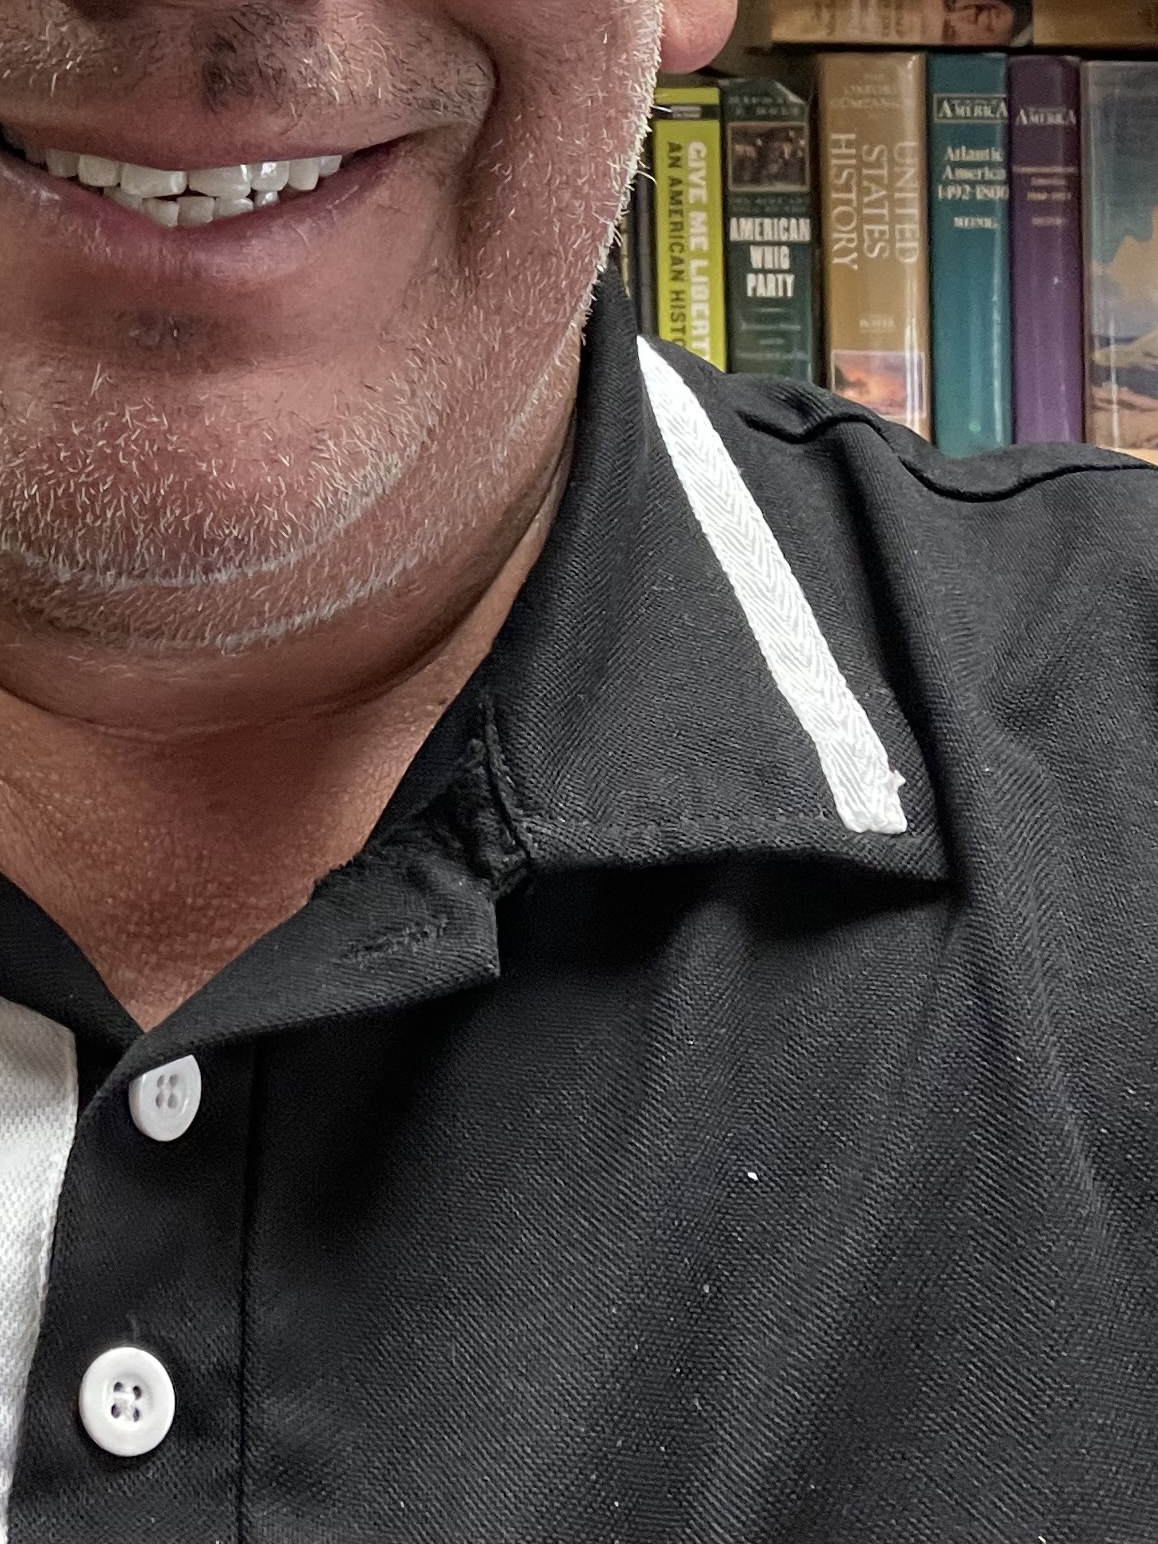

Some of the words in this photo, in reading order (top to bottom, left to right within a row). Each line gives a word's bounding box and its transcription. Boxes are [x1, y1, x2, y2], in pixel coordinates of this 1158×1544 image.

[667, 141, 682, 169] AN
[688, 140, 708, 204] GIVE
[945, 144, 1004, 161] Atlantic
[668, 177, 686, 282] AMERICAN
[830, 132, 858, 271] HISTORY
[861, 143, 890, 258] STATES
[893, 141, 920, 264] UNITED
[689, 211, 709, 251] ME
[730, 217, 812, 243] AMERICAN
[749, 244, 791, 270] WHIG
[689, 259, 711, 361] LIBERT
[746, 273, 795, 298] PARTY
[670, 290, 686, 348] HIST
